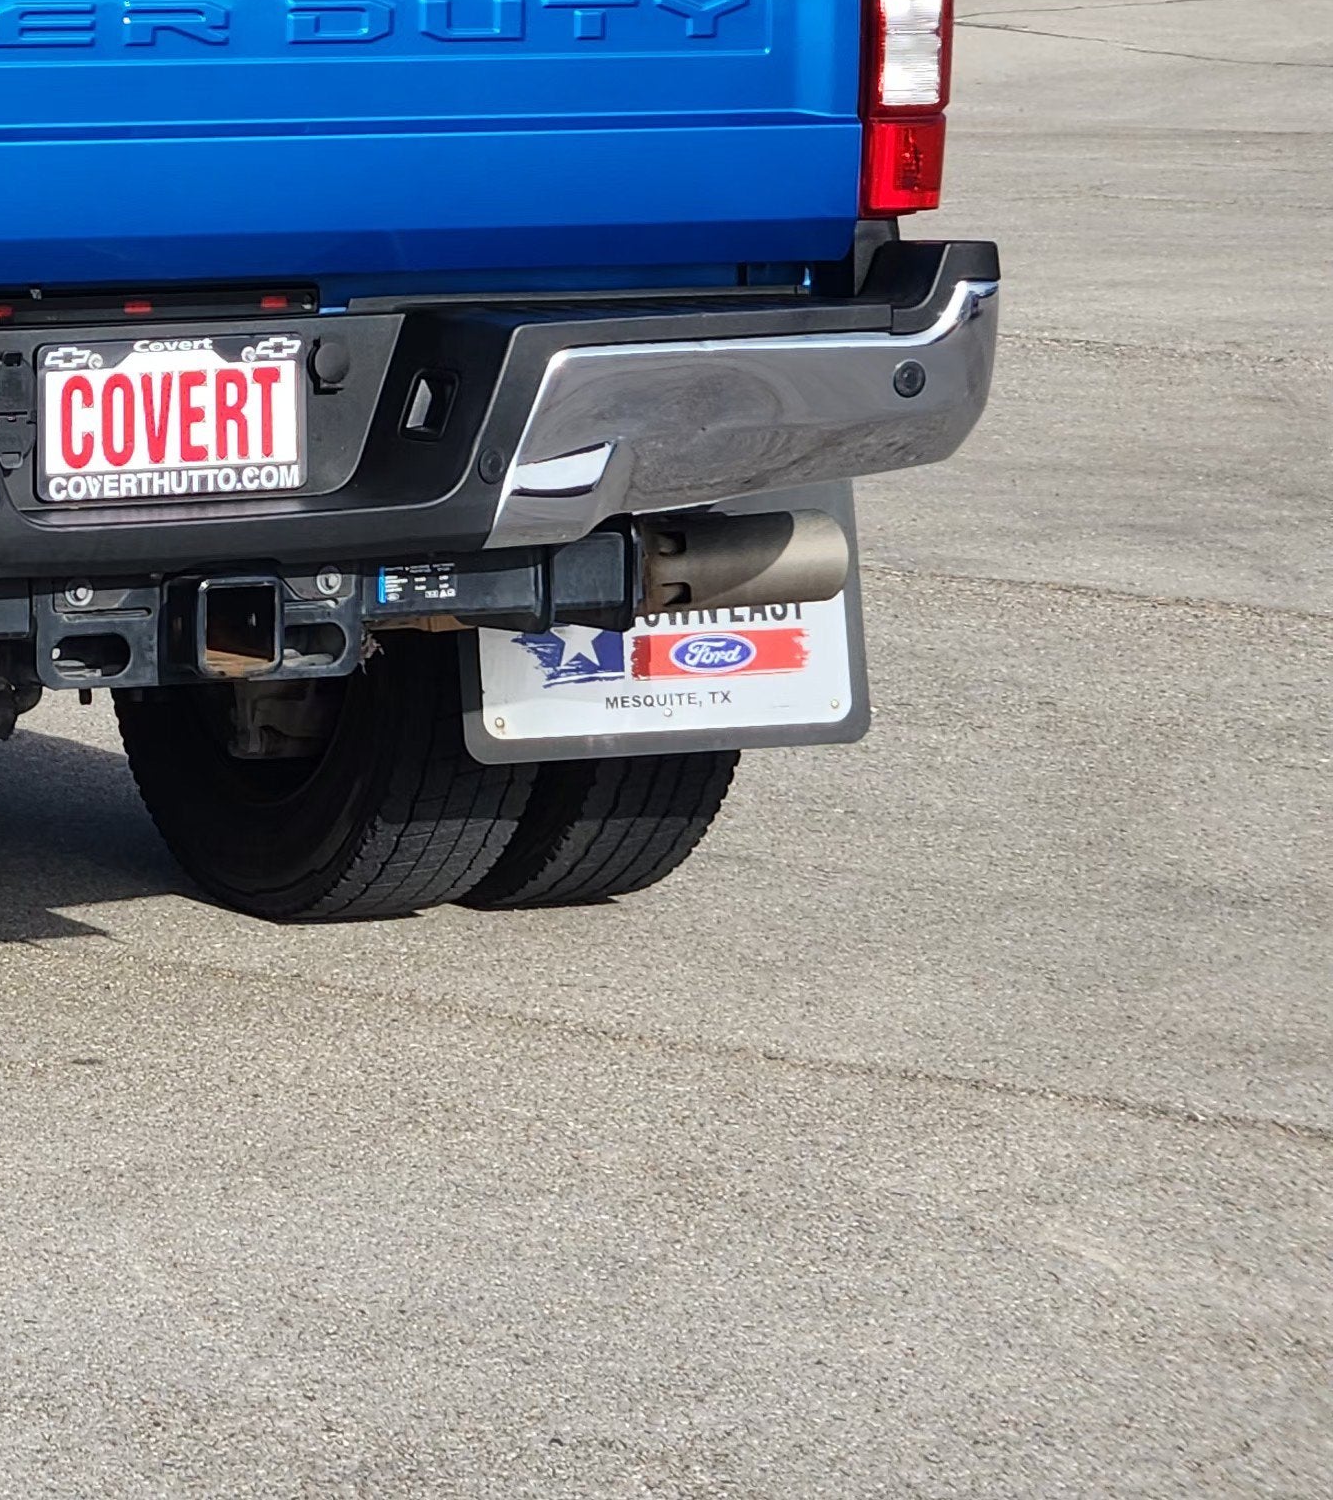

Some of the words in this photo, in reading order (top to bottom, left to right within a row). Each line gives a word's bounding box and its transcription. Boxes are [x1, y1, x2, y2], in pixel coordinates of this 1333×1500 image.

[133, 337, 213, 353] Covert
[60, 366, 281, 469] COVERT
[49, 465, 300, 501] COVERTHUTTO.COM
[684, 640, 742, 667] Ford
[605, 692, 703, 710] MESQUITE,
[709, 690, 733, 704] TX
